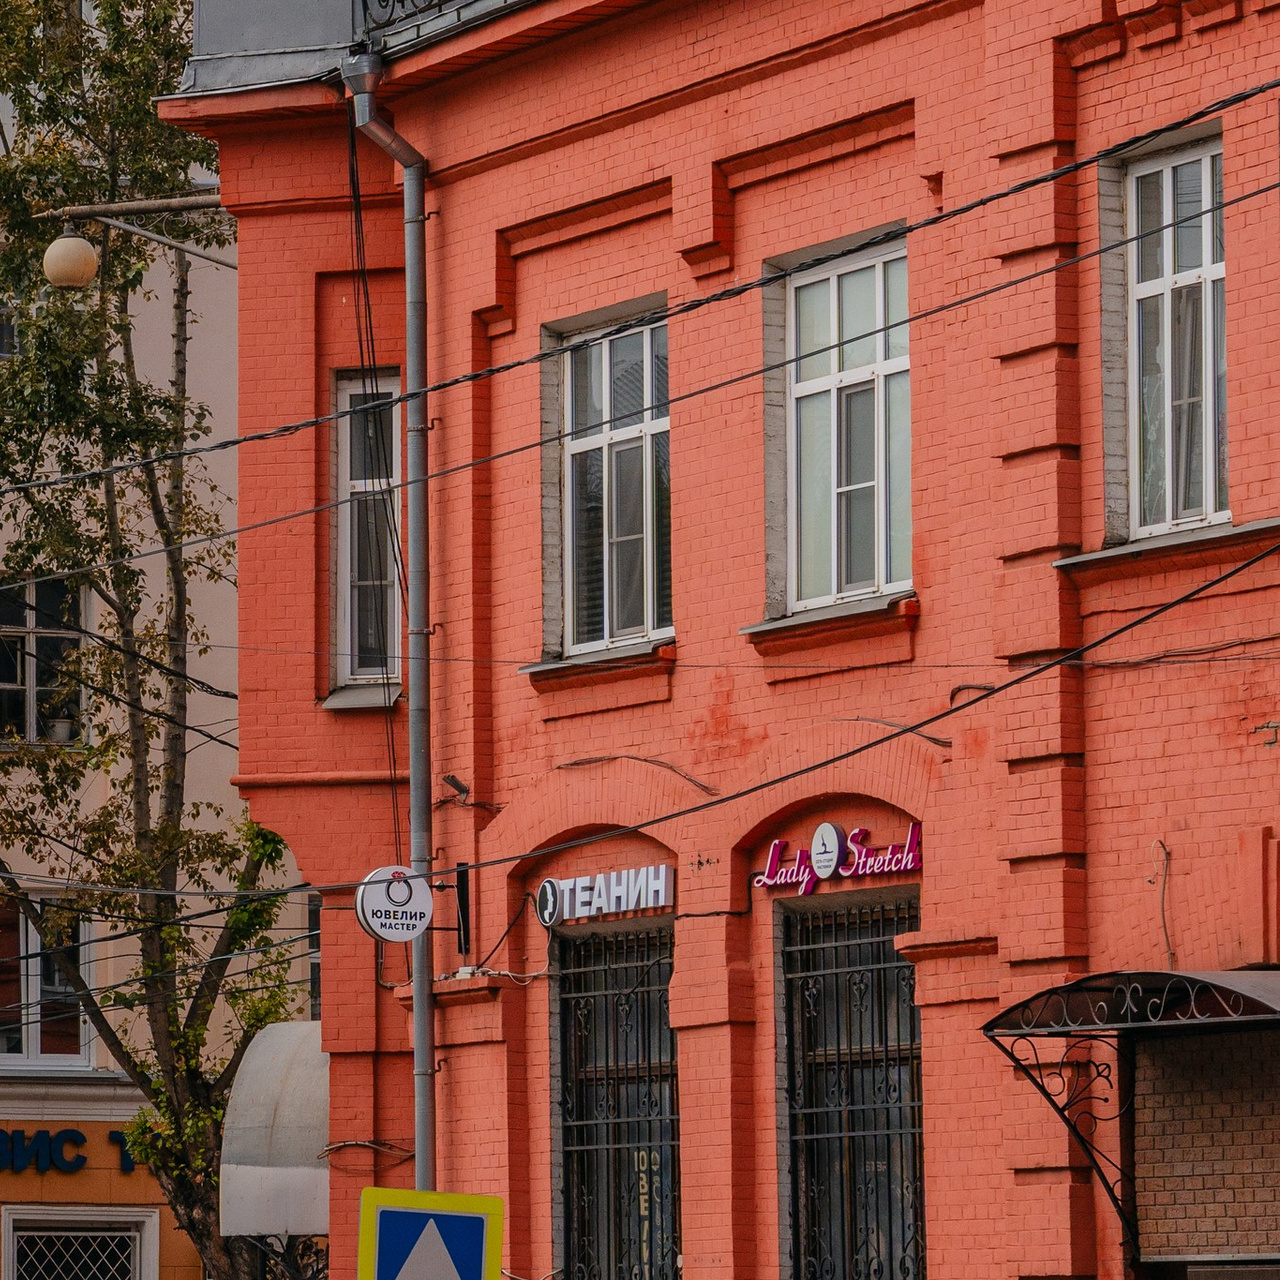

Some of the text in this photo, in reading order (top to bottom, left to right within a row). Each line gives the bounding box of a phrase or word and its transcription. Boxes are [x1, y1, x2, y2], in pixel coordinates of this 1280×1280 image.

[754, 822, 916, 896] Lady Stretch
[371, 909, 426, 921] ЮВЕЛИР
[380, 922, 417, 931] МАСТЕР
